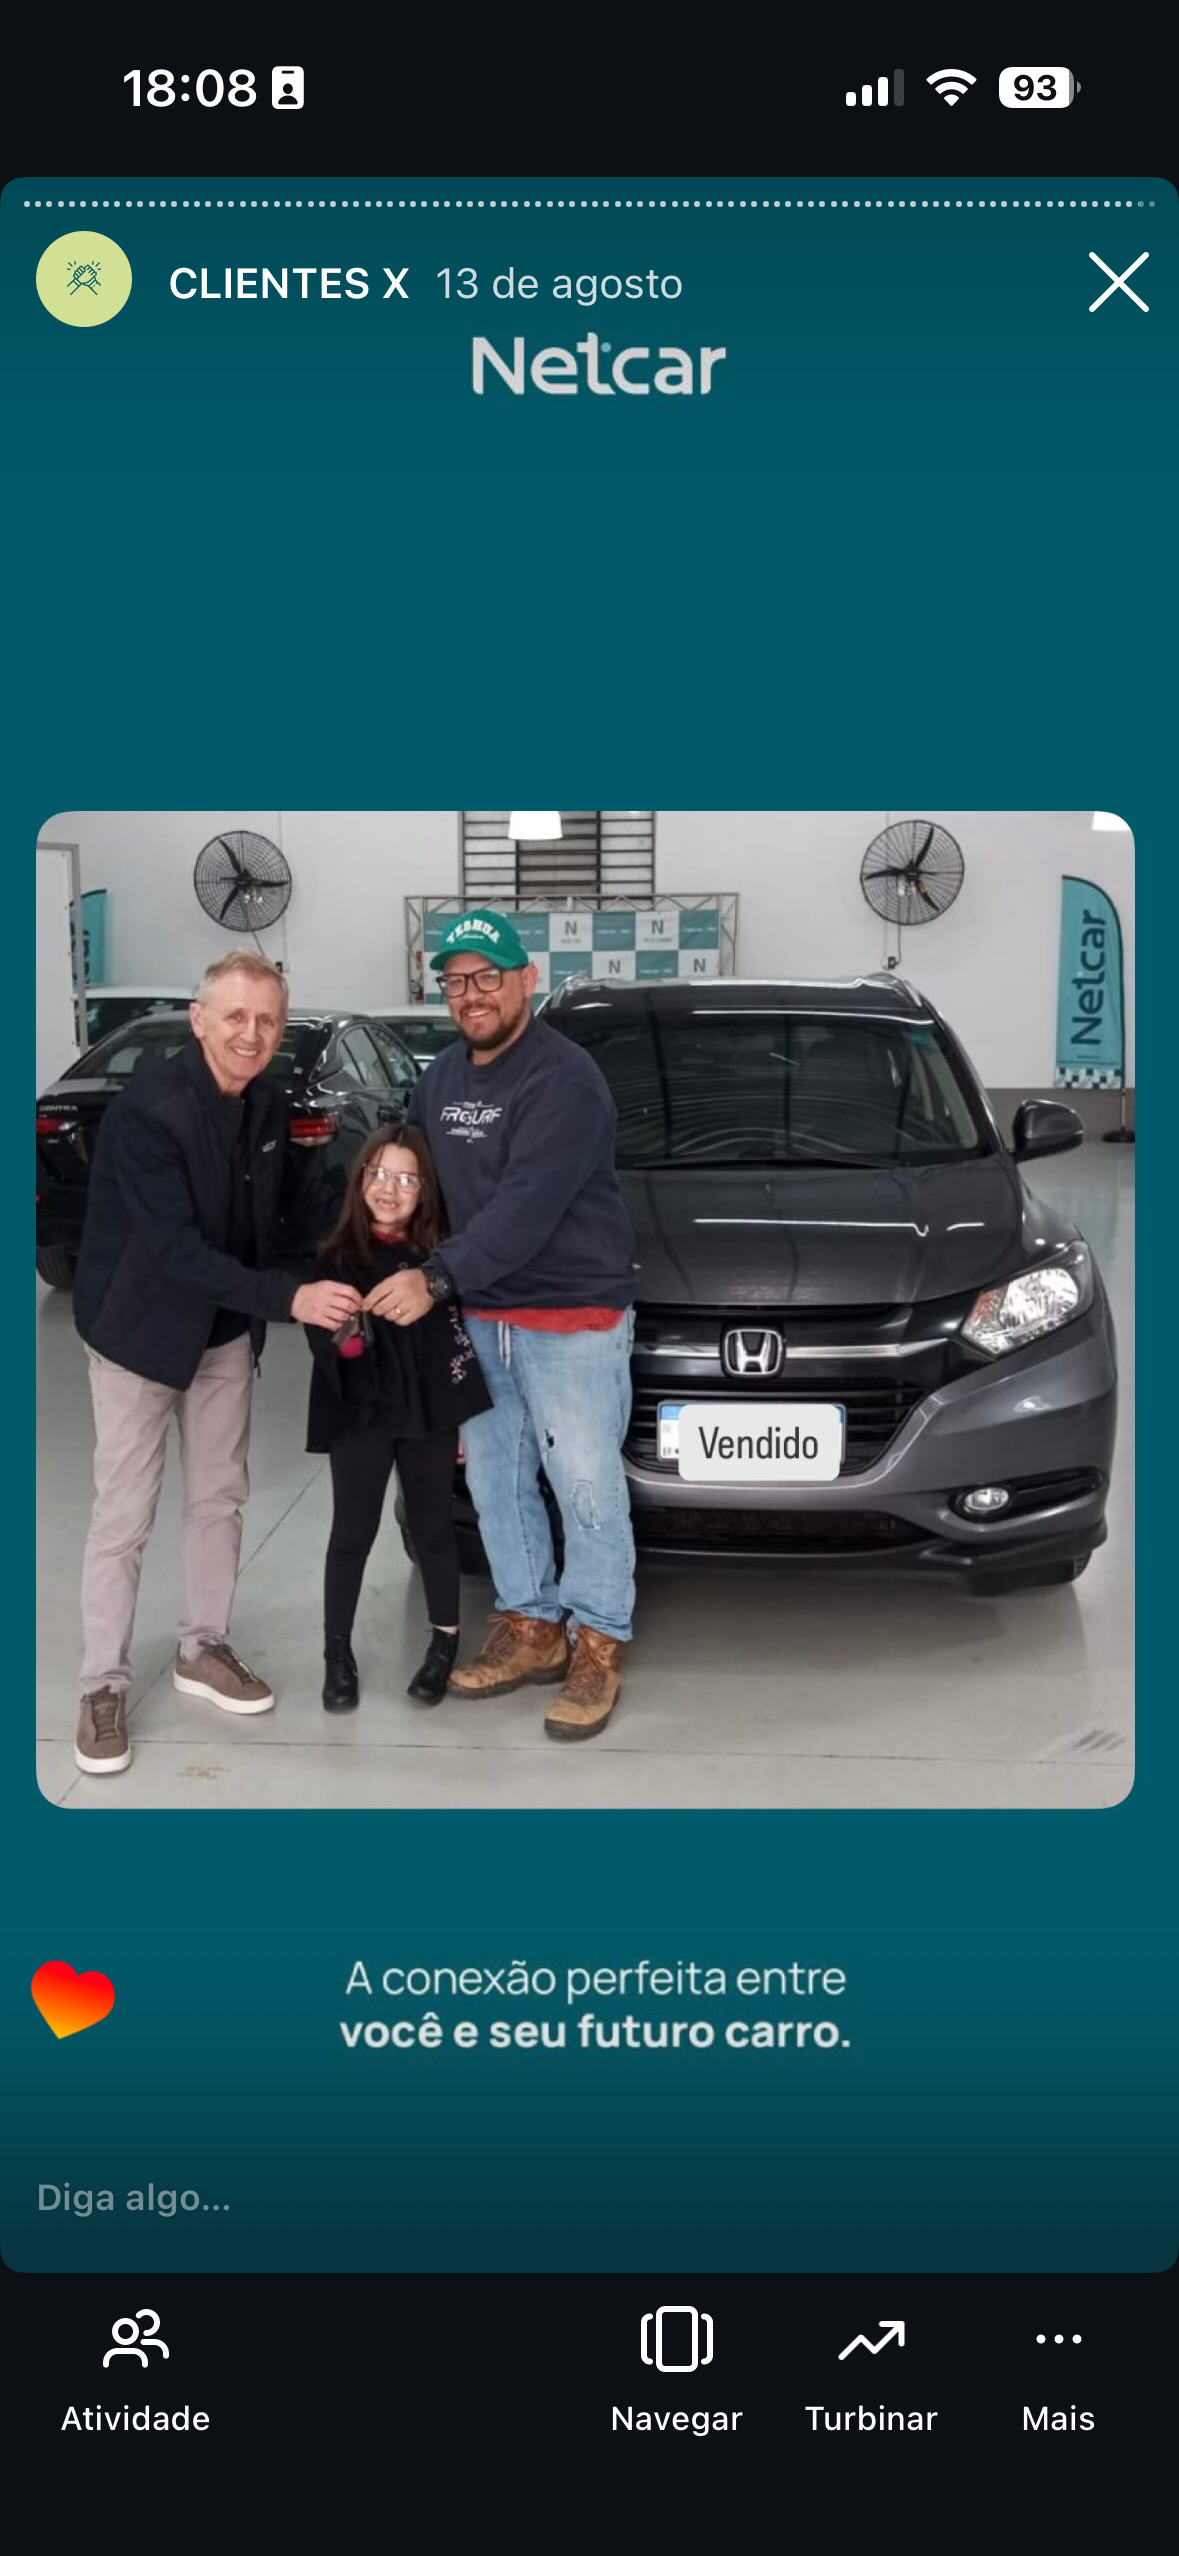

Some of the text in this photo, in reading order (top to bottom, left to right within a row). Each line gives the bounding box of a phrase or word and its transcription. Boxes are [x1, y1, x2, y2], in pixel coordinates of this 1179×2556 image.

[565, 921, 577, 935] N
[651, 920, 664, 935] N
[608, 960, 621, 974] N
[693, 958, 706, 973] N
[1071, 909, 1106, 1046] Netcar
